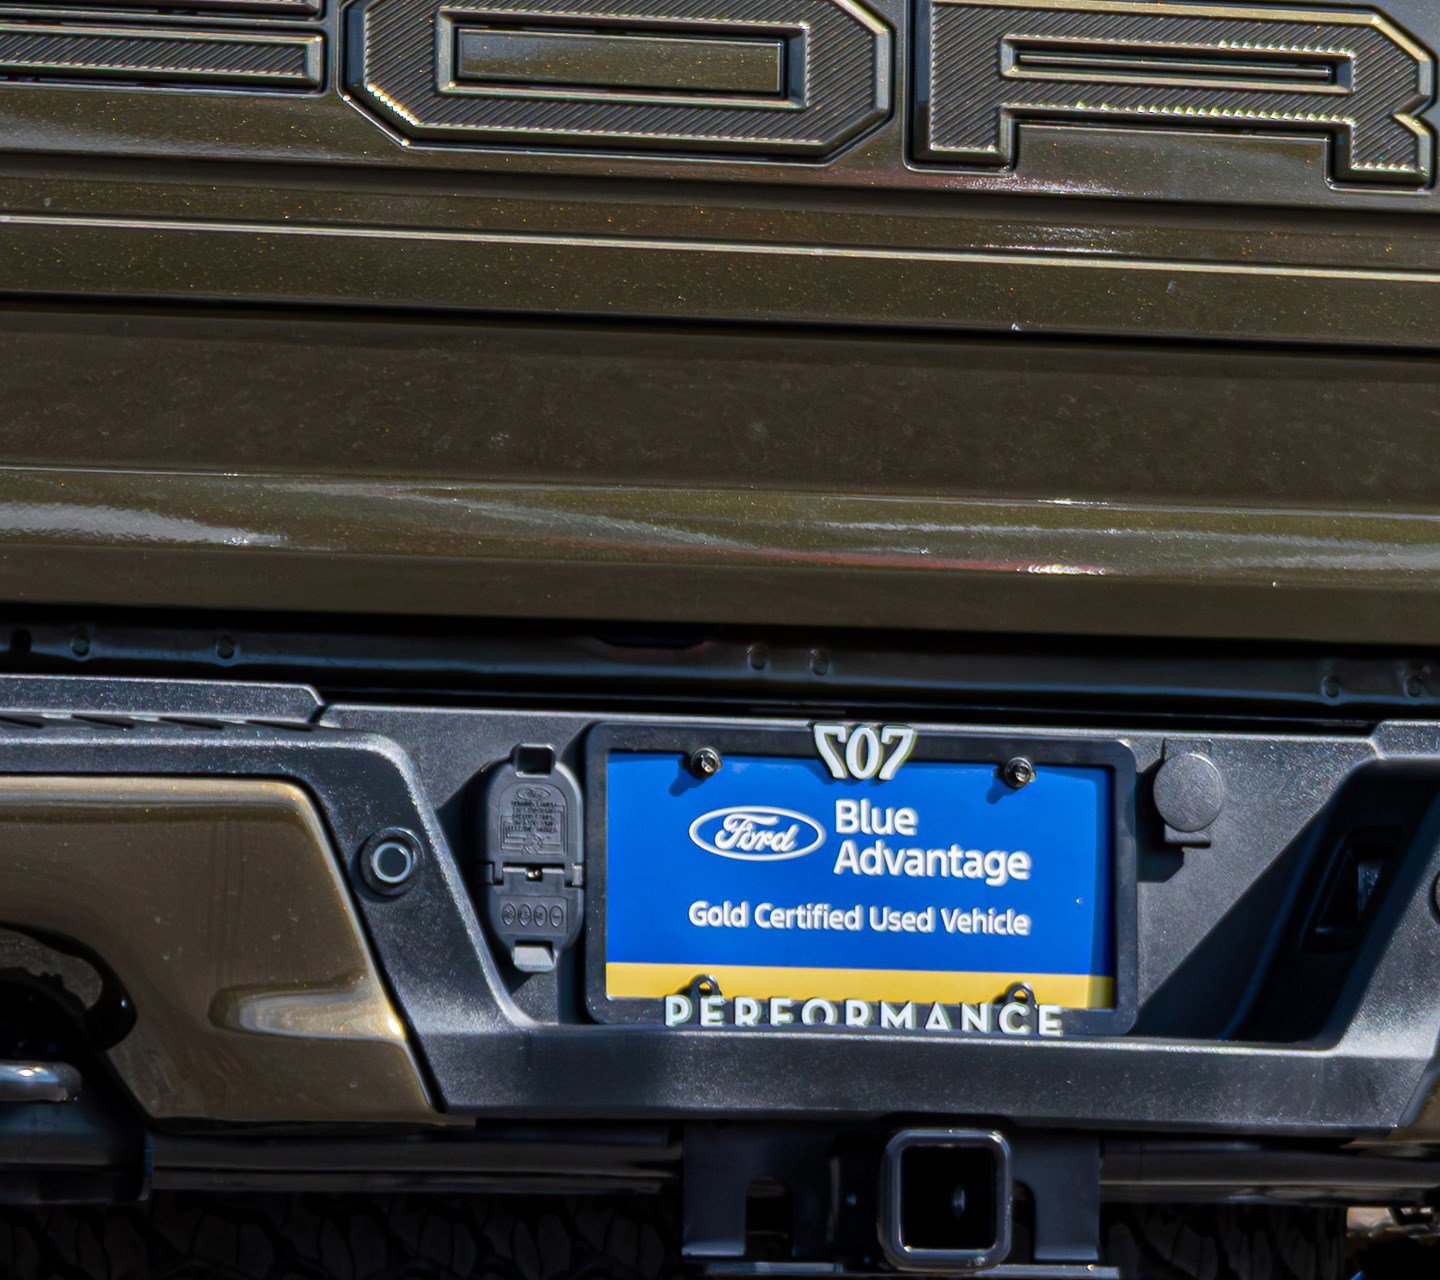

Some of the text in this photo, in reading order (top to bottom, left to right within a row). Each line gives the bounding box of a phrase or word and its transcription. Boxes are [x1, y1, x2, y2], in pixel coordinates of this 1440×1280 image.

[712, 811, 802, 853] Ford
[834, 797, 919, 836] Blue
[832, 838, 1033, 887] Advantage
[687, 899, 1032, 936] Gold Certified Used Vehicle
[663, 993, 1065, 1038] PERFORMANCE
